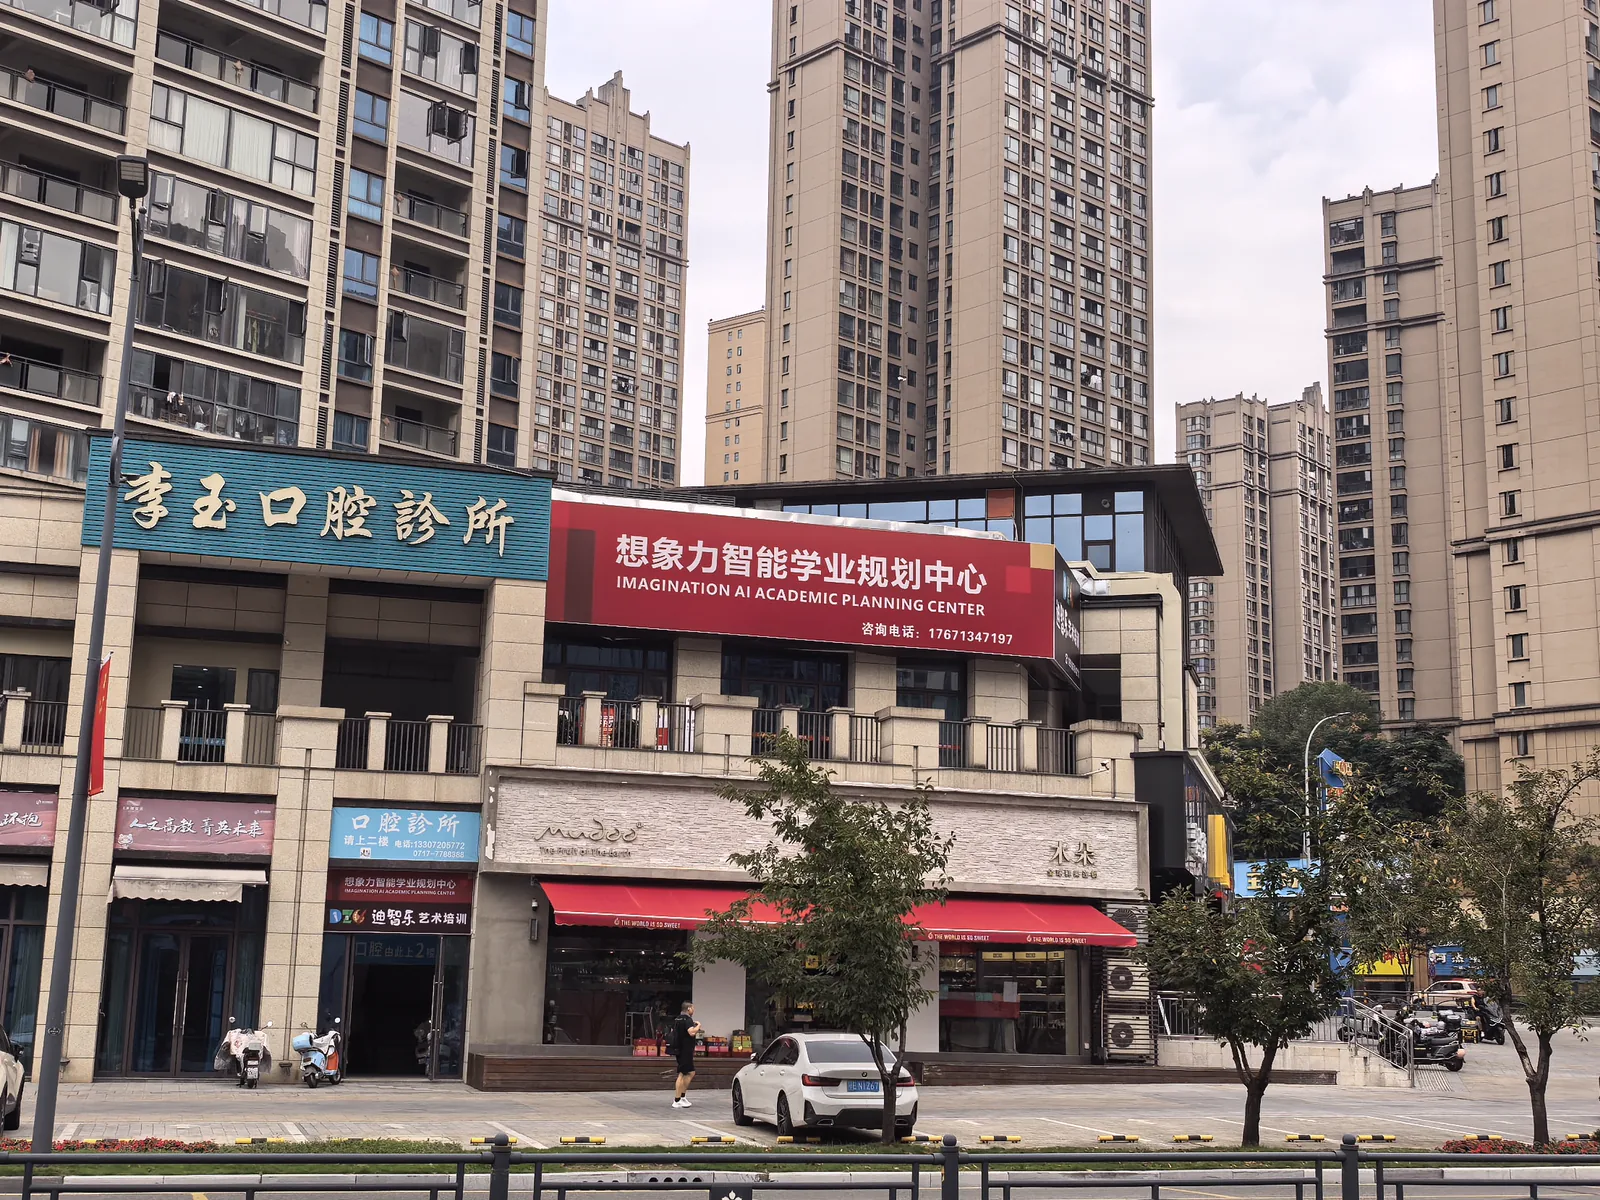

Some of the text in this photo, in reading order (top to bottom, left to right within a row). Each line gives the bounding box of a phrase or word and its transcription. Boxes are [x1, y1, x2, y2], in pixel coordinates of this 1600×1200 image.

[616, 534, 987, 595] 想象力智能学业规划中心
[617, 576, 985, 616] IMAGINATION AI ACADEMIC PLANNING CENTER
[929, 628, 1012, 645] 17671347197
[344, 835, 389, 848] 请上二楼
[344, 876, 456, 889] 想象力智能学业规划中心
